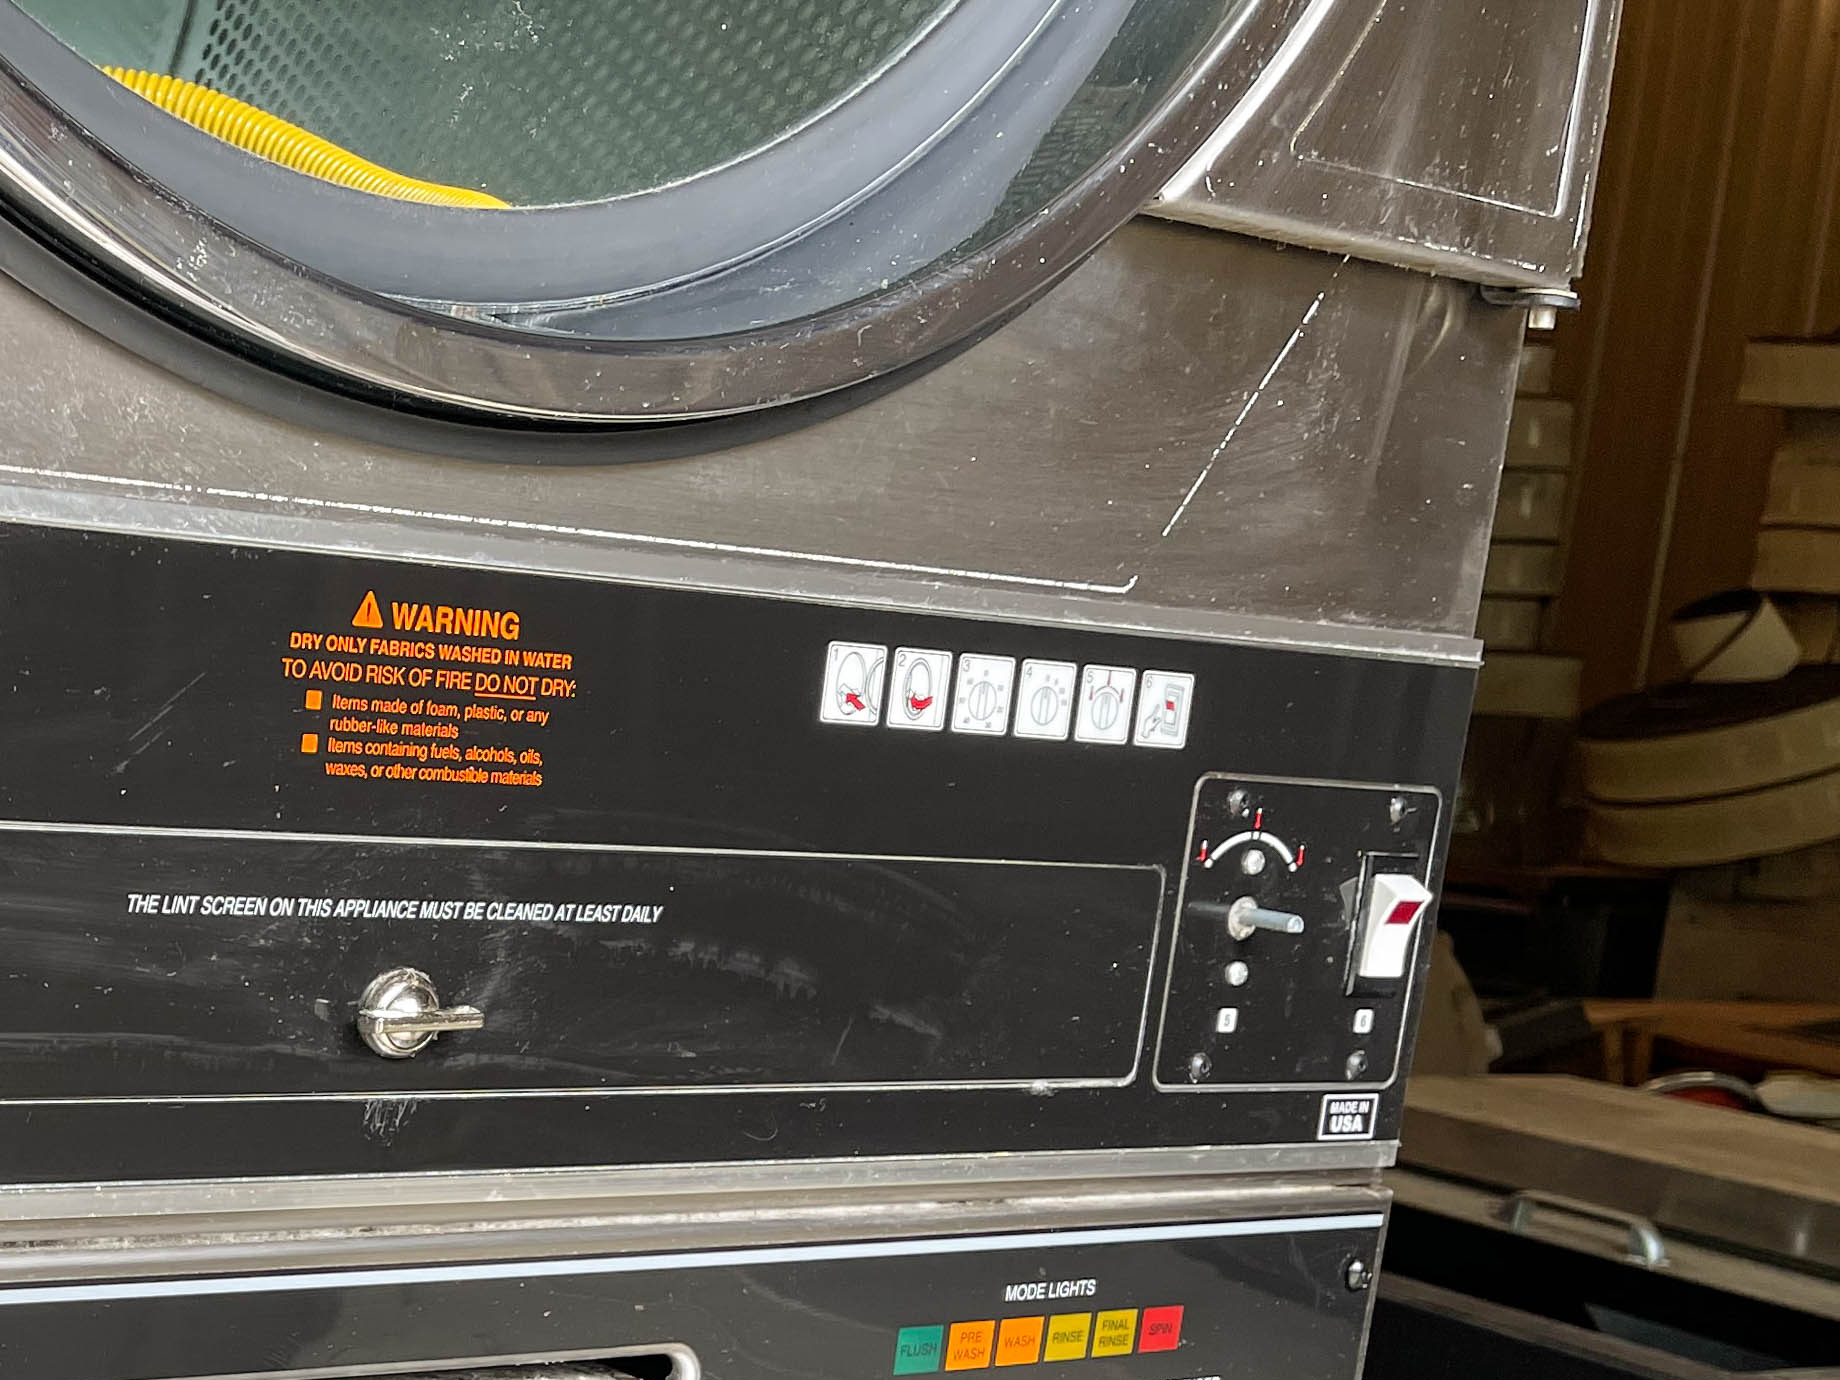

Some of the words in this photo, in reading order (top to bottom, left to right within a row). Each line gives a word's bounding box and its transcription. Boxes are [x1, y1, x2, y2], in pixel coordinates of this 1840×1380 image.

[391, 601, 520, 641] WARNING
[290, 632, 323, 650] DRY
[325, 635, 367, 654] ONLY
[370, 638, 435, 660] FABRICS
[438, 643, 502, 665] WASHED
[505, 649, 520, 666] IN
[523, 651, 572, 670] WATER
[282, 657, 307, 678] TO
[309, 660, 363, 682] AVOID
[365, 665, 406, 686] RISK
[409, 668, 433, 688] OF
[436, 670, 473, 692] FIRE
[475, 673, 501, 693] DO
[503, 676, 537, 696] NOT
[541, 679, 577, 698] DRY:
[332, 693, 368, 713] Items
[371, 697, 408, 715] made
[411, 699, 425, 716] of
[526, 710, 549, 726] any
[330, 716, 399, 736] rubber-like
[400, 721, 459, 740] materials
[328, 737, 363, 755] Items
[365, 742, 428, 762] containing
[465, 745, 518, 766] alcohols,
[325, 762, 368, 781] waxes,
[418, 766, 489, 786] combustible
[490, 770, 543, 788] materials
[127, 894, 161, 914] THE
[161, 896, 200, 915] LINT
[200, 896, 268, 917] SCREEN
[269, 897, 297, 917] ON
[297, 898, 335, 918] THIS
[333, 899, 420, 920] APPLIANCE
[419, 901, 464, 920] MUST
[464, 902, 486, 921] BE
[486, 903, 554, 922] CLEANED
[553, 904, 577, 922] AT
[575, 905, 622, 923] LEAST
[621, 906, 664, 924] DAILY
[1330, 1101, 1358, 1114] MADE
[1358, 1101, 1370, 1114] IN
[1329, 1114, 1363, 1133] USA
[1005, 1282, 1047, 1303] MODE
[1047, 1278, 1097, 1299] LIGHTS
[1102, 1319, 1130, 1332] FINAL
[1148, 1321, 1173, 1337] SPIN
[961, 1331, 983, 1345] PRE
[1004, 1334, 1036, 1349] WASH
[1052, 1330, 1084, 1344] RINSE
[1099, 1334, 1128, 1348] RINSE
[900, 1342, 938, 1357] FLUSH
[953, 1347, 985, 1361] WASH
